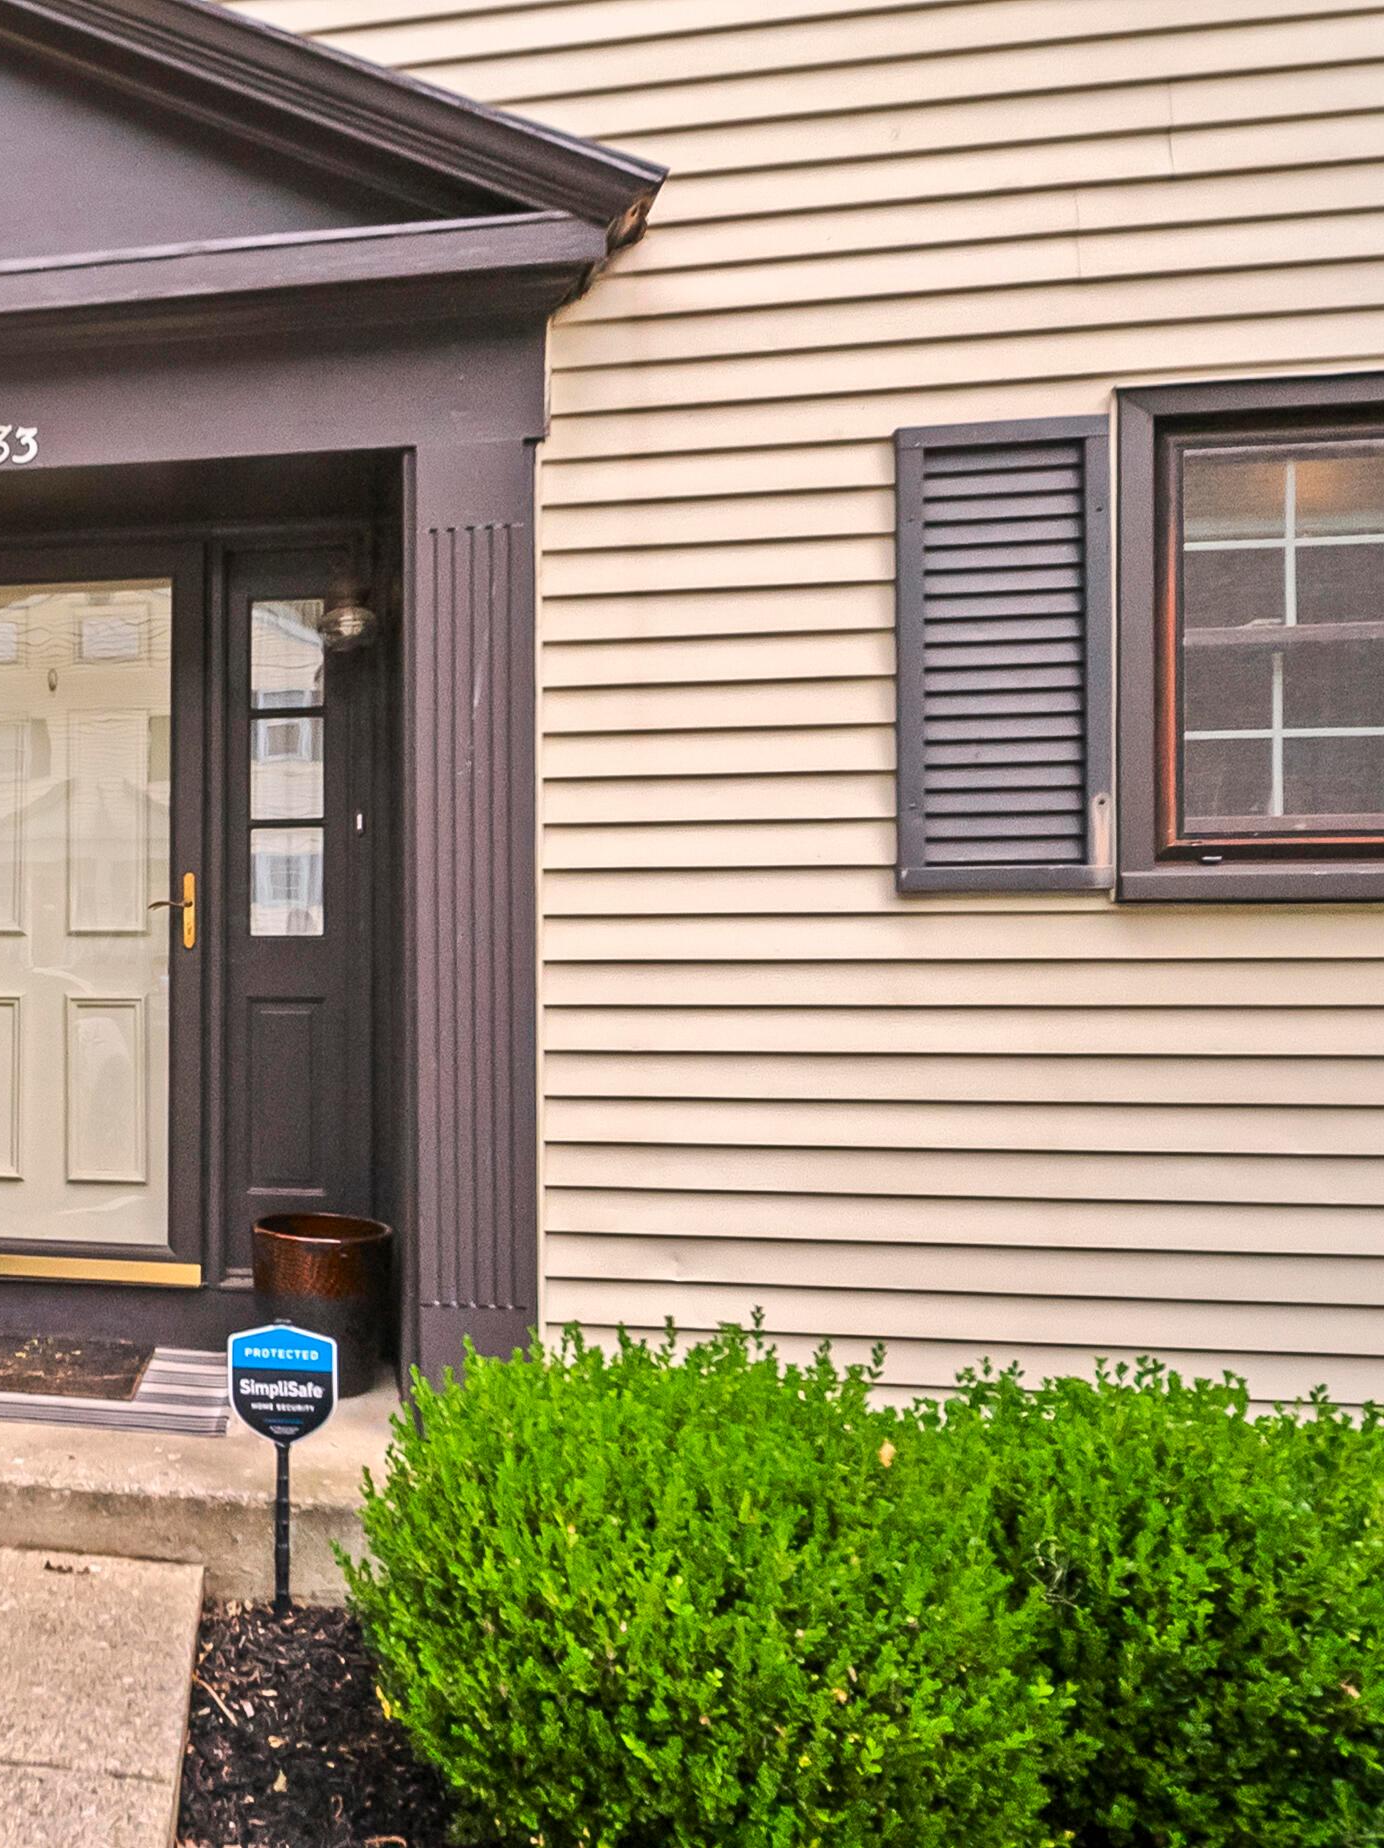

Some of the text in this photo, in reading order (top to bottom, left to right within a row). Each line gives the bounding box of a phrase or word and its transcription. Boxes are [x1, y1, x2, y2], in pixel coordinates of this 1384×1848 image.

[244, 1347, 319, 1361] PROTECTED
[239, 1378, 324, 1399] SimpliSafe
[276, 1403, 315, 1412] SECURITY
